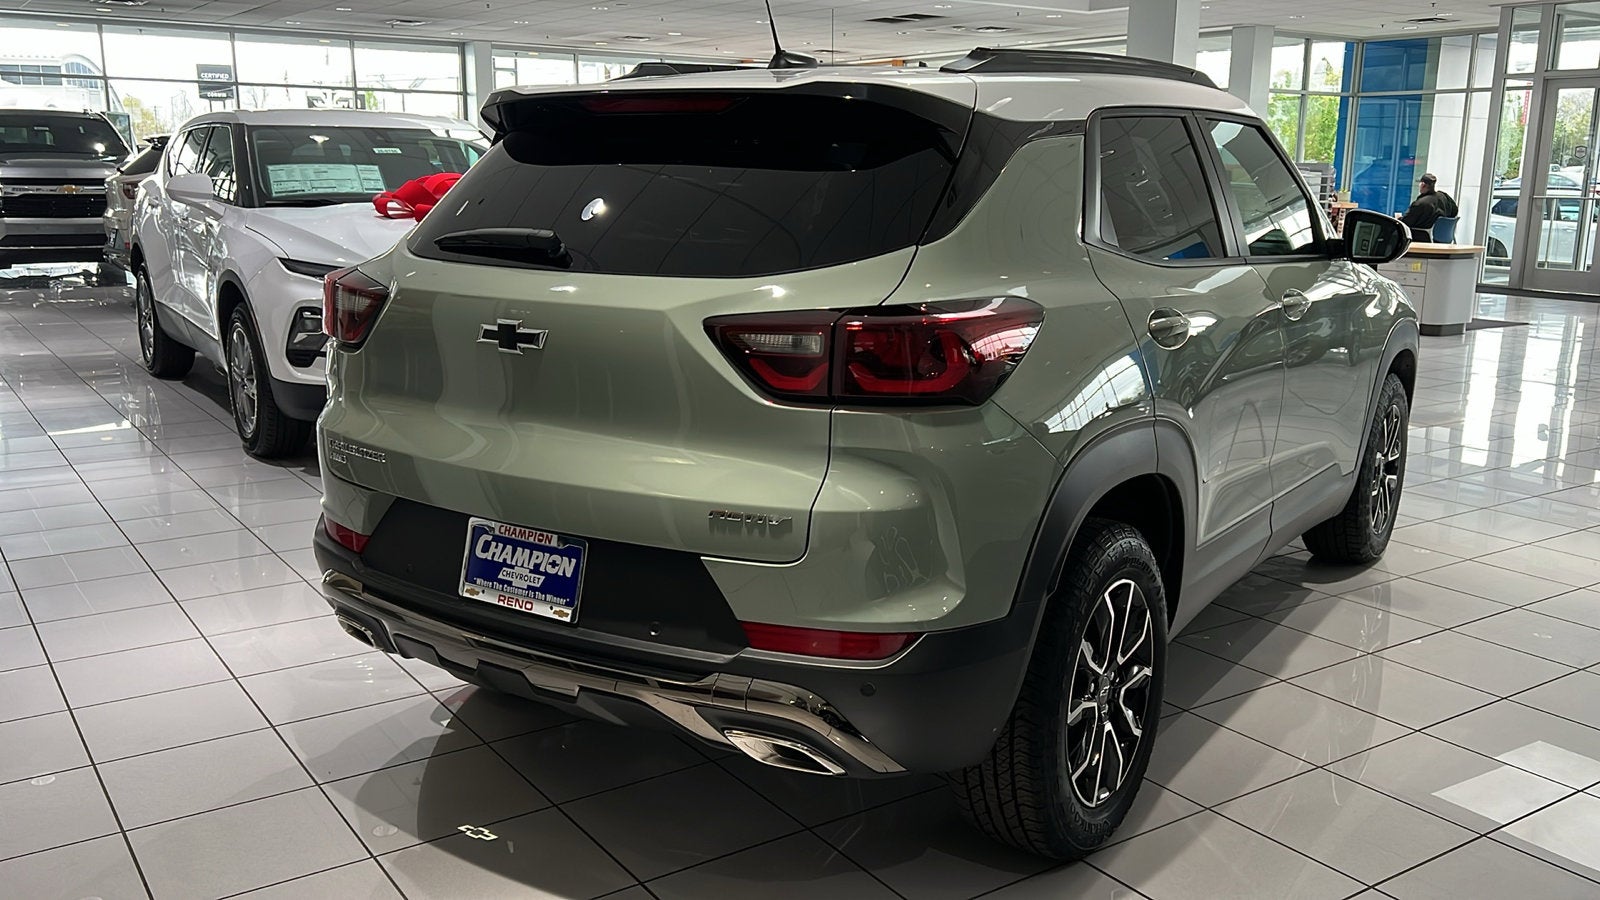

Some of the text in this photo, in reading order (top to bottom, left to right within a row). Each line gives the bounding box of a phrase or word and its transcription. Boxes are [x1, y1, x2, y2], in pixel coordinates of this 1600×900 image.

[498, 525, 553, 545] CHAMPION
[475, 534, 577, 578] CHAMPION
[501, 569, 541, 585] CHEVROLET
[493, 581, 503, 590] The
[503, 584, 528, 597] Customer
[535, 591, 545, 601] The
[497, 594, 534, 611] RENO
